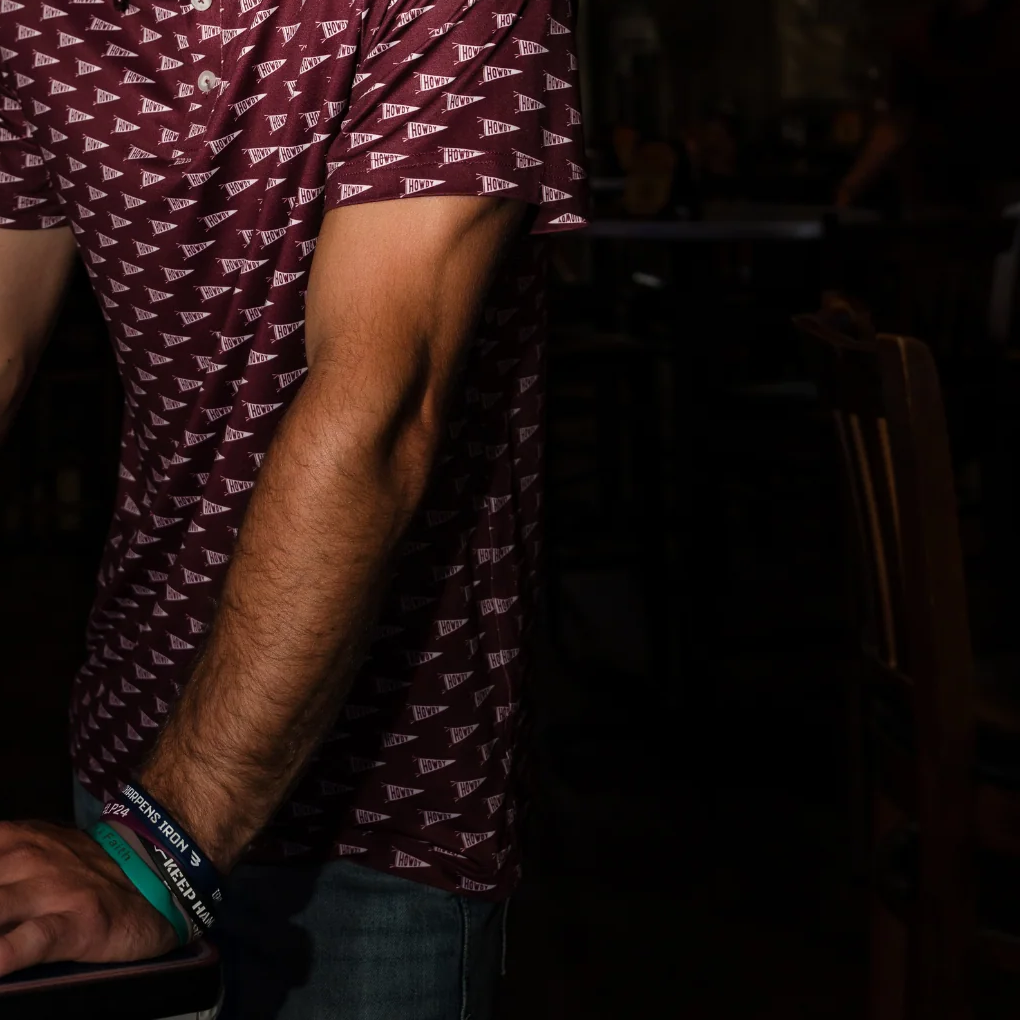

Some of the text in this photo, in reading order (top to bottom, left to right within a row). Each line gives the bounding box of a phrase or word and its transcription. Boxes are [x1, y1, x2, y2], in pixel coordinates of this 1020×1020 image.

[522, 41, 544, 54] HOWDY
[259, 61, 281, 76] HOWDY
[487, 67, 512, 80] HOWDY
[423, 75, 449, 89] HOWDY
[237, 96, 258, 114] HOWDY
[450, 93, 474, 108] HOWDY
[385, 104, 410, 118] HOWDY
[412, 122, 436, 137] HOWDY
[487, 120, 511, 134] HOWDY
[211, 133, 234, 152] HOWDY
[353, 133, 372, 145] HOWDY
[280, 146, 303, 162] HOWDY
[373, 153, 399, 167] HOWDY
[447, 148, 474, 163] HOWDY
[228, 180, 250, 194] HOWDY
[343, 185, 362, 196] HOWDY
[408, 179, 434, 192] HOWDY
[487, 178, 510, 193] HOWDY
[544, 186, 565, 202] HOWDY
[207, 211, 229, 226] HOWDY
[266, 228, 285, 246] HOWD
[278, 322, 299, 339] HOWDY
[224, 336, 245, 349] HOWDY
[250, 402, 275, 417] HOWDY
[415, 705, 439, 719] HOWDY
[422, 759, 446, 772] HOWDY
[390, 786, 414, 799] HOWDY
[158, 820, 189, 853] IRON
[163, 858, 196, 900] KEEP
